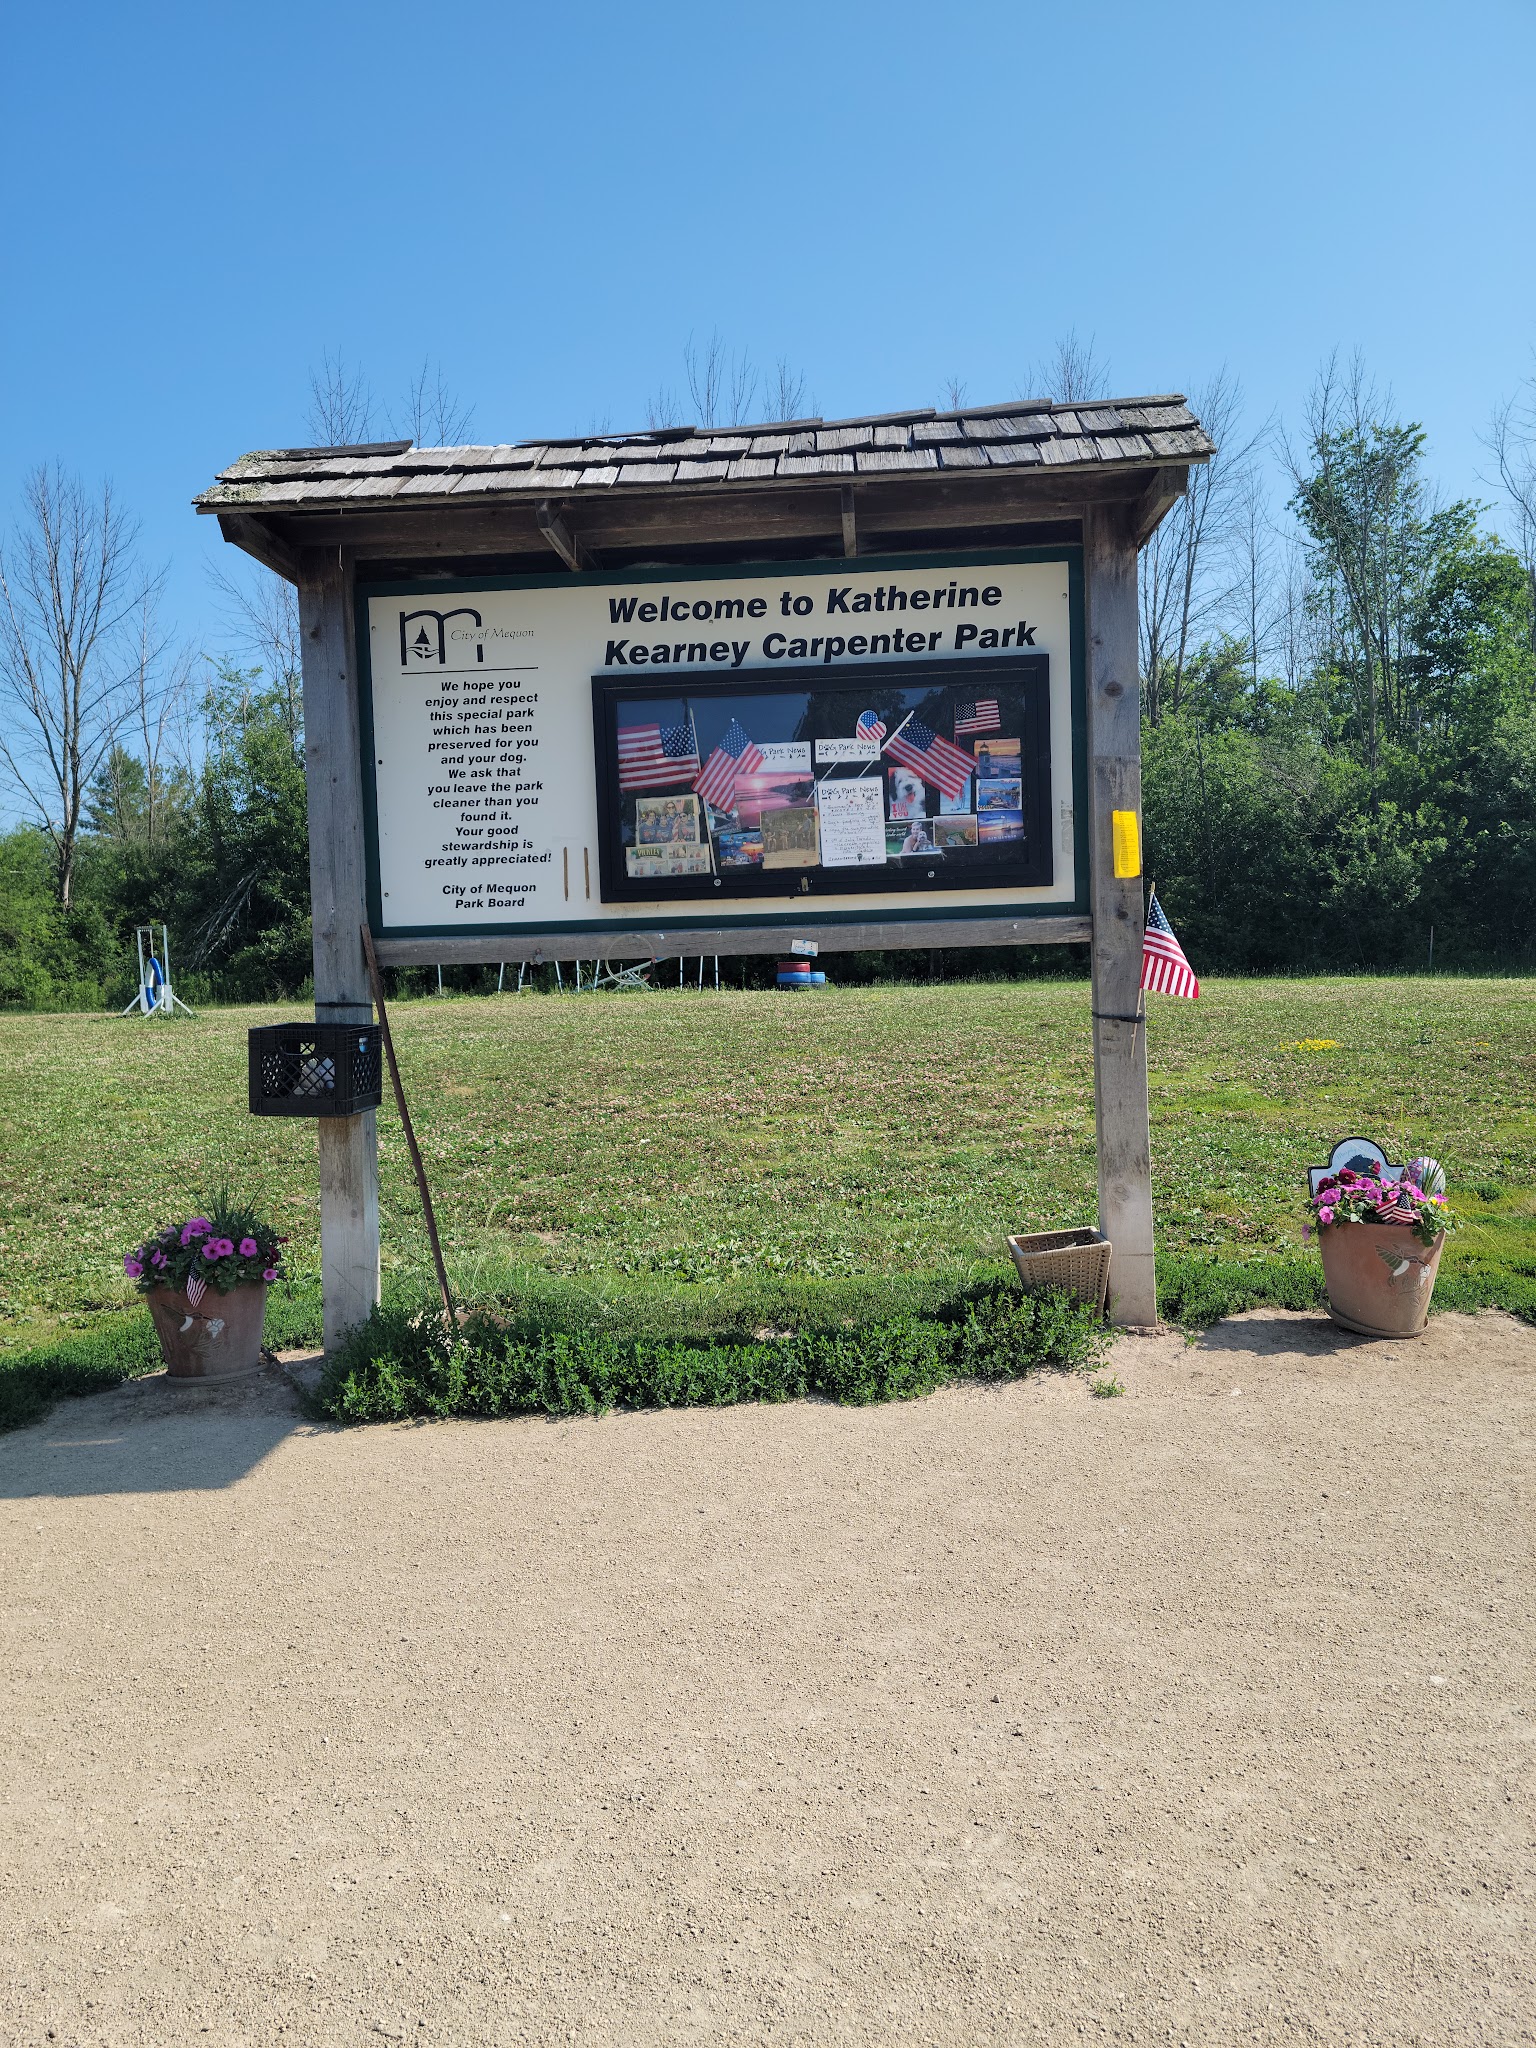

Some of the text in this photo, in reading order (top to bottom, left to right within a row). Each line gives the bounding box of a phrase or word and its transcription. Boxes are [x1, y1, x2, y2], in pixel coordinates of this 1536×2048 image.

[609, 582, 1002, 623] Welcome to Katherine
[450, 628, 535, 642] City of Mequon
[605, 621, 1037, 668] Kearney Carpenter Park
[442, 681, 520, 692] We hope you
[426, 694, 537, 708] enjoy and respect
[430, 708, 534, 722] this special park
[433, 724, 532, 735] which has been
[428, 739, 538, 752] preserved for you
[769, 747, 785, 755] Park
[441, 753, 526, 765] and your dog.
[449, 768, 520, 778] We ask that
[428, 781, 543, 796] you leave the park
[433, 797, 538, 808] cleaner than you
[461, 811, 511, 821] found it.
[456, 826, 518, 837] Your good
[442, 840, 533, 851] stewardship is
[425, 854, 550, 868] greatly appreciated!
[443, 884, 536, 896] City of Mequon
[456, 898, 524, 908] Park Board
